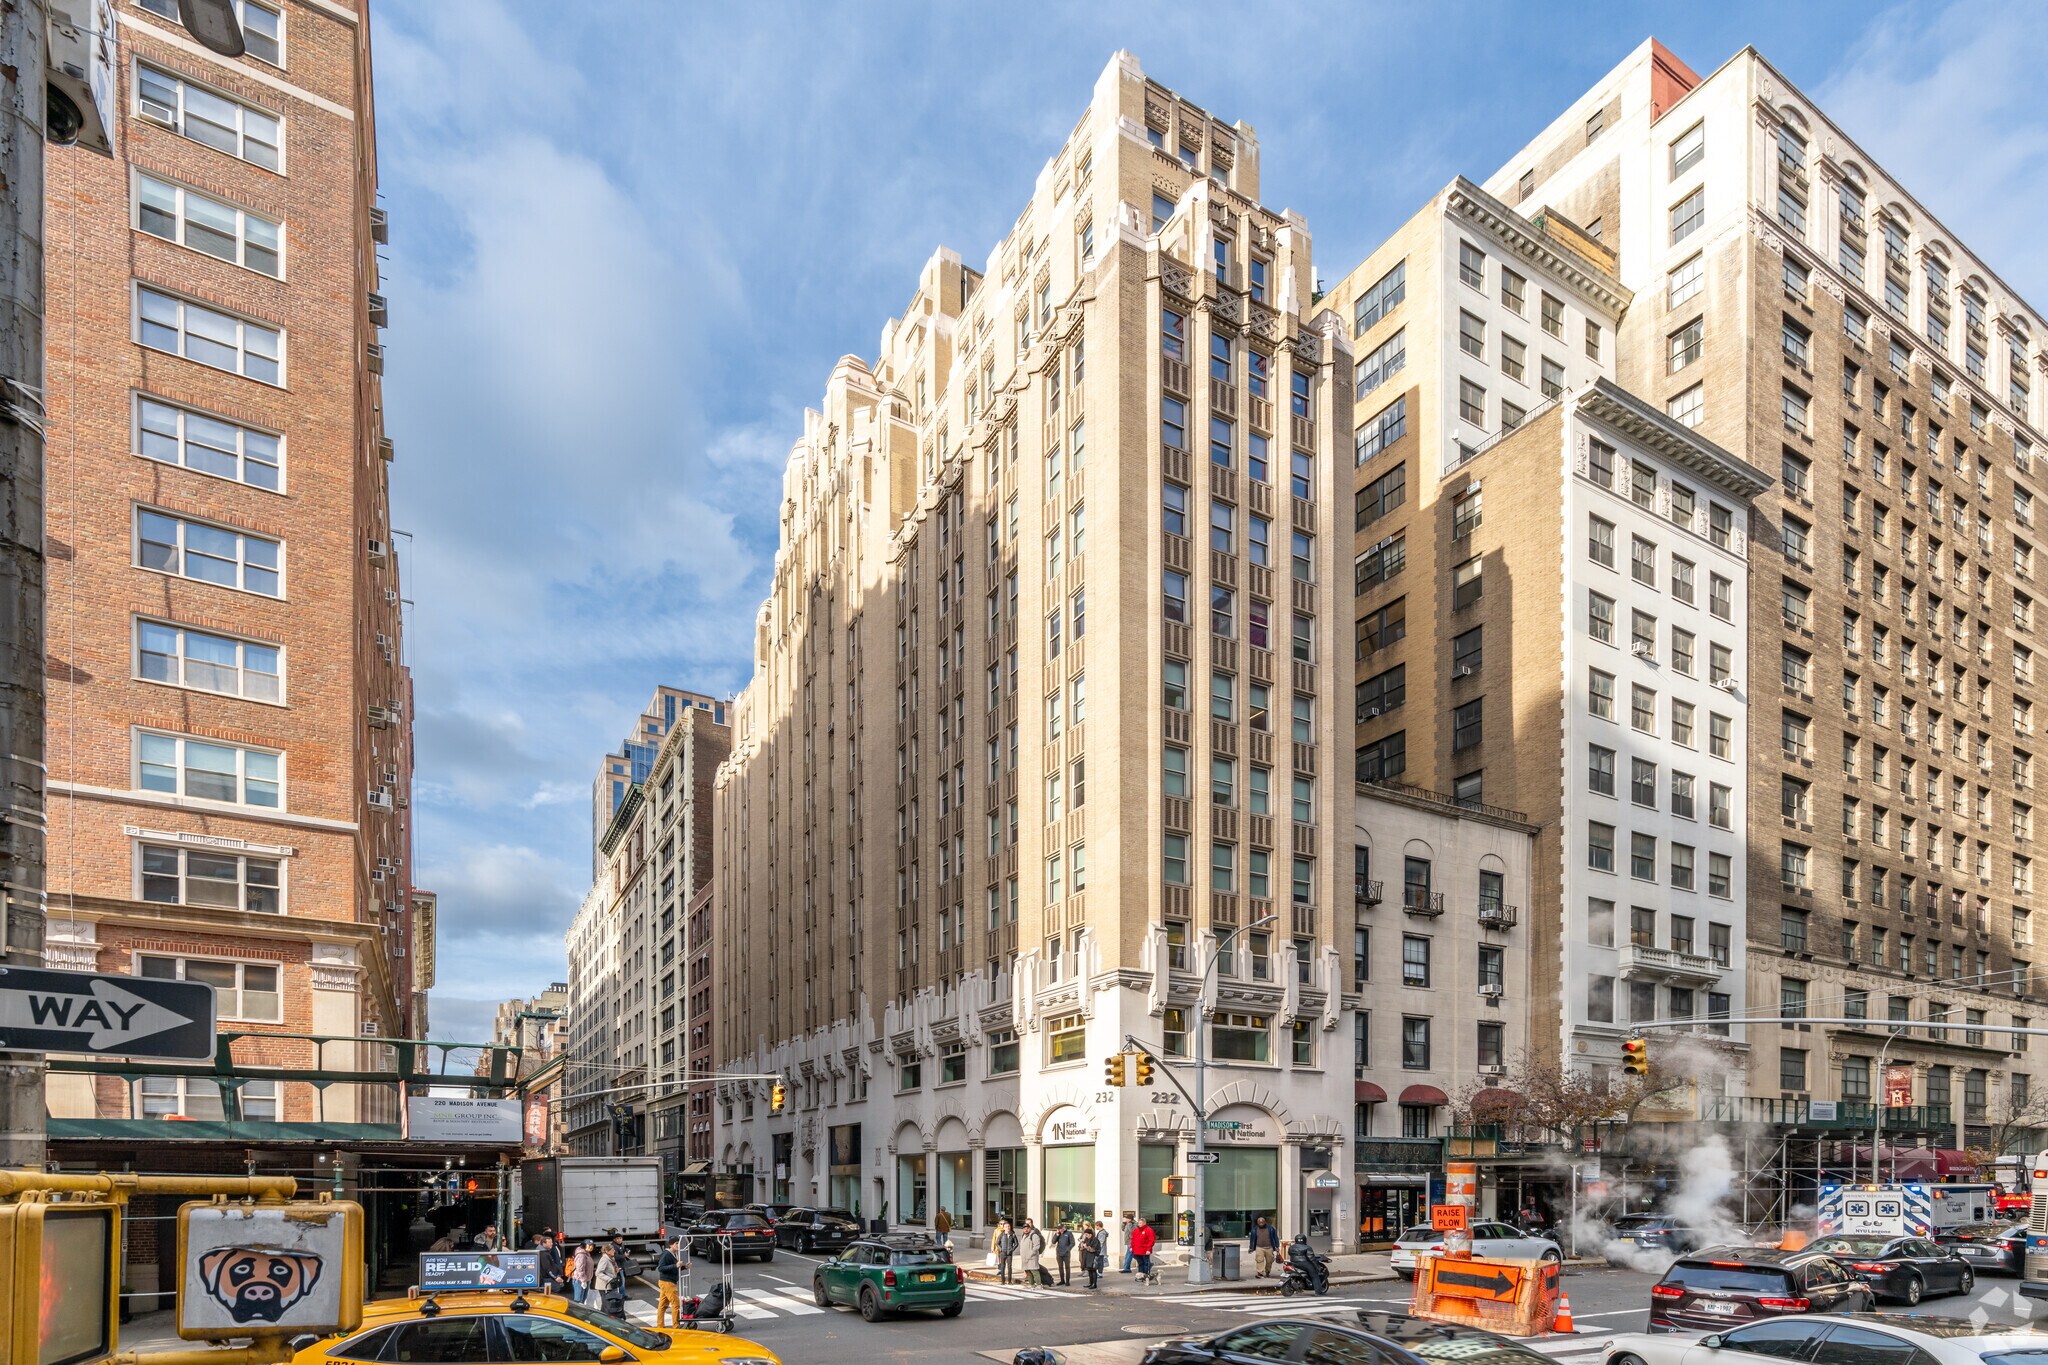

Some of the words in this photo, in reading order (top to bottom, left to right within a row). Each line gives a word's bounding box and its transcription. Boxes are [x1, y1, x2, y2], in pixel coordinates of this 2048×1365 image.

[28, 994, 146, 1031] WAY
[1095, 1091, 1114, 1103] 232
[1151, 1091, 1180, 1104] 232
[1066, 1128, 1086, 1136] National
[1437, 1209, 1461, 1217] RAISE
[1438, 1219, 1460, 1227] PLOW
[425, 1262, 466, 1272] REAL
[467, 1262, 482, 1271] ID
